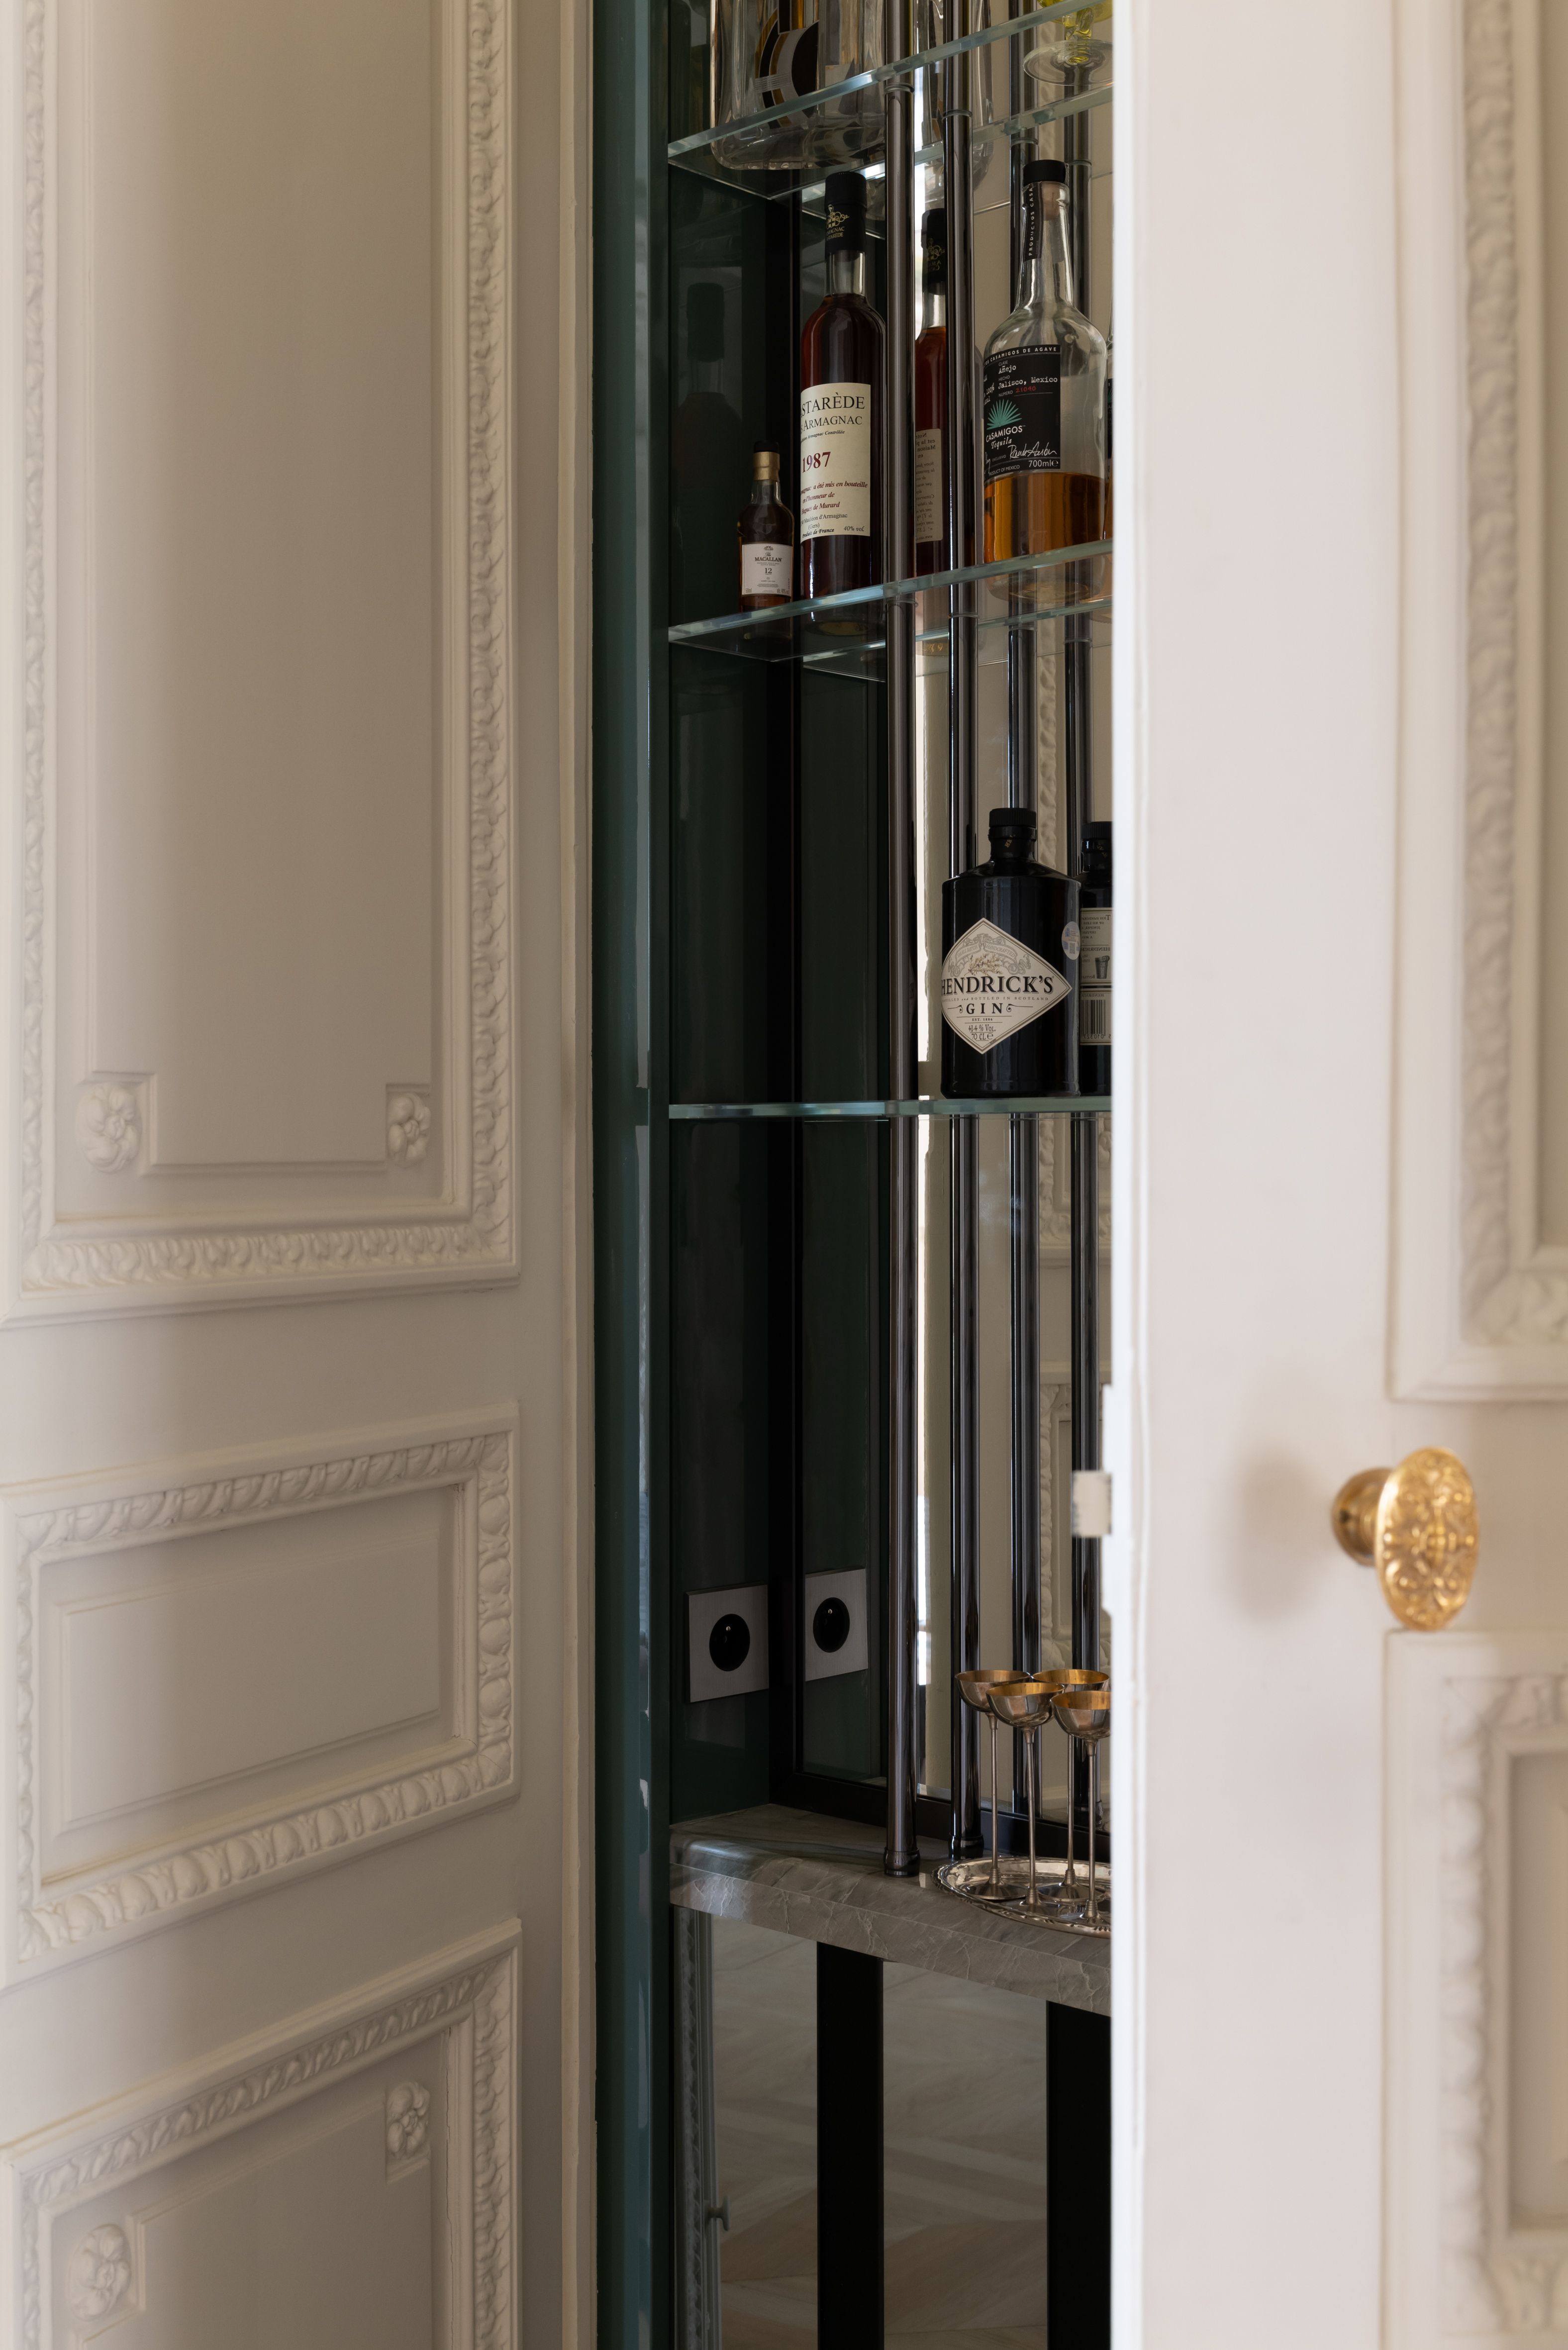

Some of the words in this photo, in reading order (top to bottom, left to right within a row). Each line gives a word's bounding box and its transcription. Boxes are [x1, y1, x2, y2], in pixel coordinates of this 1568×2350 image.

[990, 350, 1019, 362] CASAMIGOS
[998, 365, 1016, 374] Añejo
[998, 380, 1026, 390] Jalisco,
[803, 416, 863, 431] ARMAGNAC
[986, 425, 1023, 443] CASAMIGOS
[991, 437, 1012, 450] Tequila
[802, 451, 831, 473] 1987
[942, 976, 1053, 996] HENDRICK'S
[966, 1003, 1003, 1014] GIN
